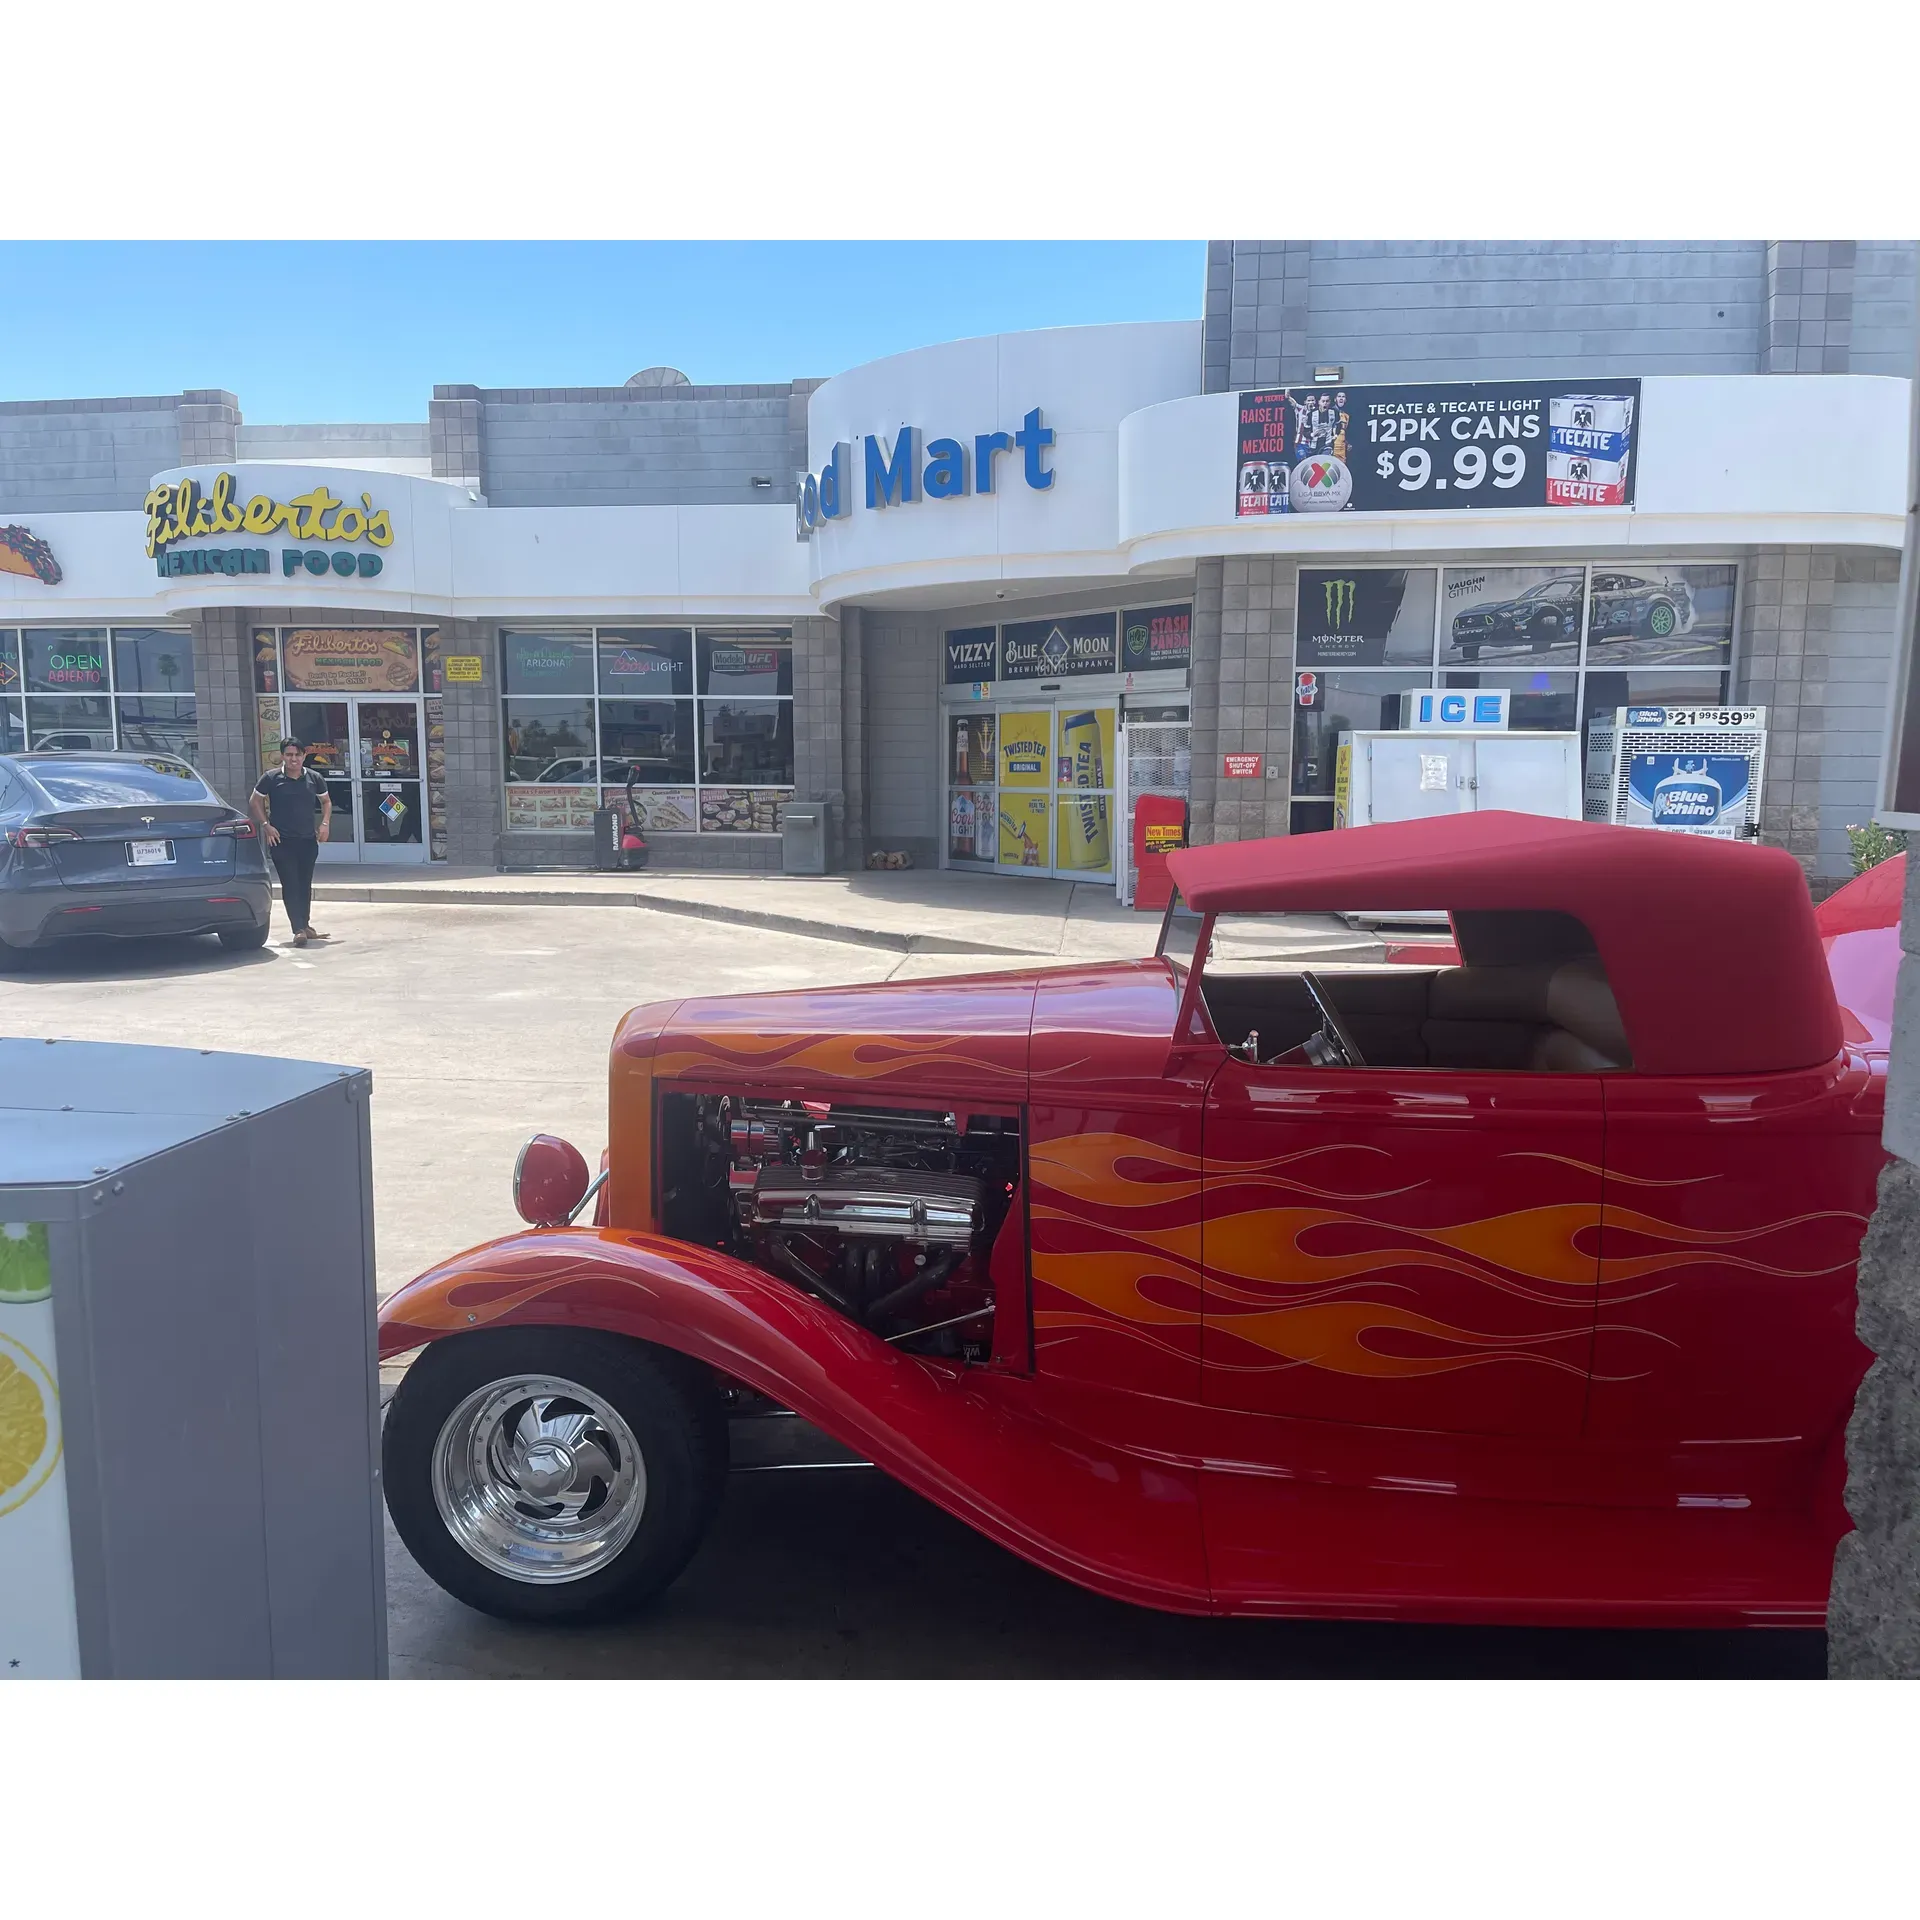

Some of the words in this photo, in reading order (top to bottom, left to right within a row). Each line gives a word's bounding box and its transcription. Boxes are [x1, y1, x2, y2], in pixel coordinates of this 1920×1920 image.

[1242, 408, 1272, 424] RAISE
[1275, 407, 1285, 422] IT
[1369, 403, 1423, 415] TECATE
[1426, 402, 1436, 414] &
[1440, 400, 1495, 413] TECATE
[1500, 400, 1542, 412] LIGHT
[1264, 422, 1284, 438] FOR
[1367, 417, 1441, 442] 12PK
[1450, 414, 1540, 440] CANS
[1242, 438, 1284, 454] MEXICO
[1557, 428, 1614, 450] TECATE
[797, 441, 851, 542] ood
[865, 406, 1056, 510] Mart
[1376, 444, 1526, 491] $9.99
[1553, 480, 1608, 502] TECATE
[144, 472, 394, 558] Filiberto's
[156, 548, 270, 578] MEXICAN
[282, 548, 384, 578] FOOD
[1448, 576, 1485, 590] VAUGHN
[1448, 584, 1482, 599] GITTIN
[1151, 615, 1188, 634] STASH
[292, 634, 379, 657] Filiberto's
[1151, 632, 1190, 650] PANDA
[1312, 634, 1364, 644] MONSTER
[715, 653, 744, 664] Modelo
[748, 653, 773, 664] UFC
[949, 642, 995, 662] VIZZY
[50, 654, 102, 669] OPEN
[526, 658, 566, 668] ARIZONA
[612, 657, 650, 672] Coors
[651, 662, 684, 672] LIGHT
[1065, 660, 1109, 670] COMPANY
[48, 670, 100, 682] ABIERTO
[1420, 695, 1502, 722] ICE
[1004, 741, 1032, 758] TWISTED
[1034, 740, 1046, 758] TEA
[1076, 742, 1091, 772] TEA
[1668, 791, 1708, 802] Blue
[1664, 802, 1714, 816] Rhino
[953, 826, 973, 834] LIGHT
[1147, 827, 1161, 836] New
[1162, 826, 1182, 836] Times
